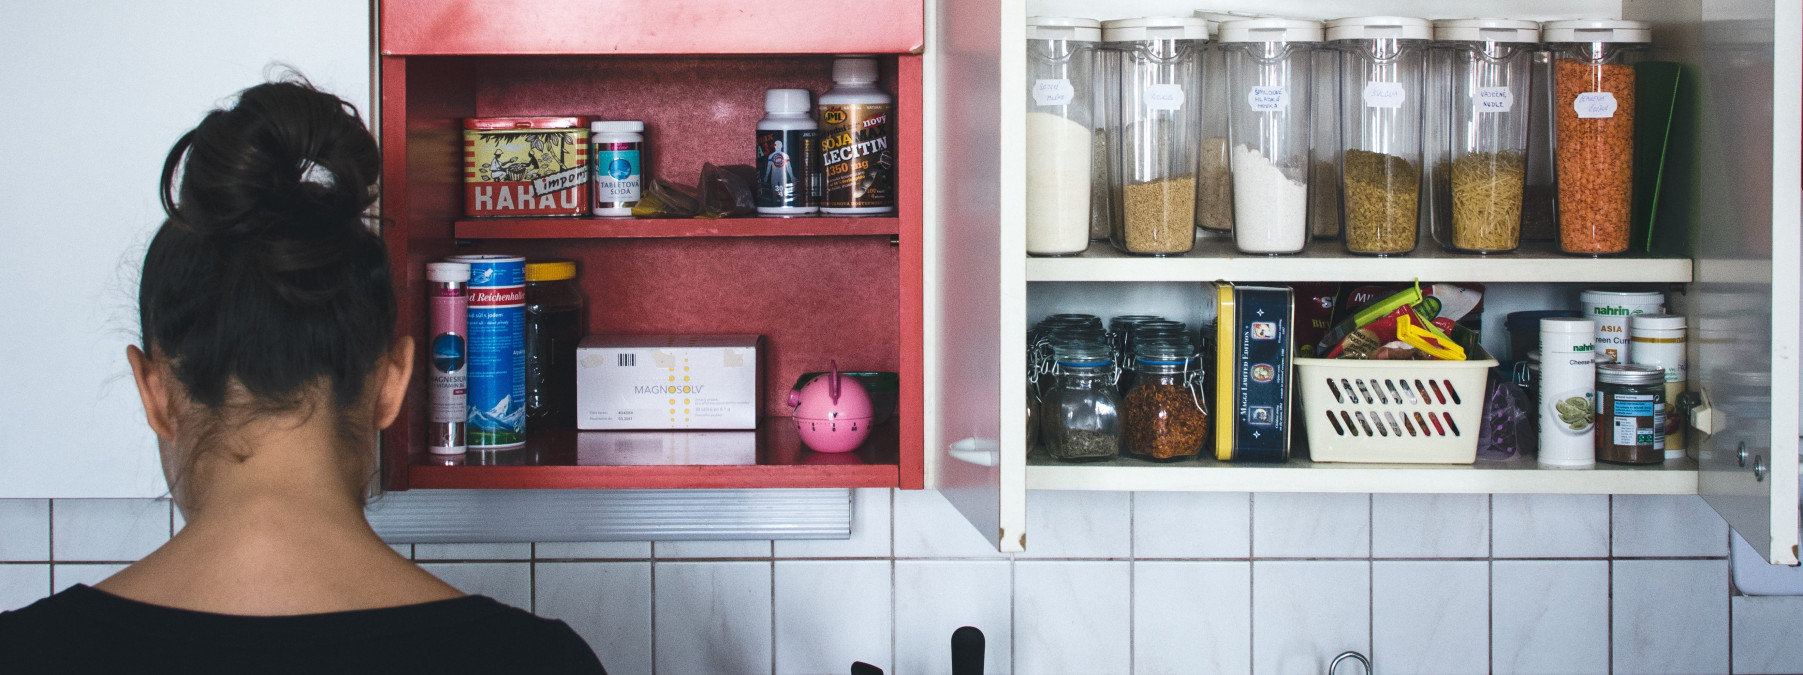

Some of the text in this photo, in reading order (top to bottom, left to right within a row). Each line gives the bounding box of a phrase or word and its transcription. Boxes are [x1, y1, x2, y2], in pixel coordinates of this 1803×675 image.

[863, 113, 887, 128] nový
[823, 136, 889, 167] LECITIN
[542, 165, 588, 191] import
[1594, 305, 1630, 315] nahrin
[1600, 325, 1623, 333] ASIA
[1242, 331, 1250, 361] EDITION
[1595, 336, 1631, 345] reen Curr
[1241, 362, 1249, 391] LIMITED
[634, 385, 702, 394] MAGNOSOLV
